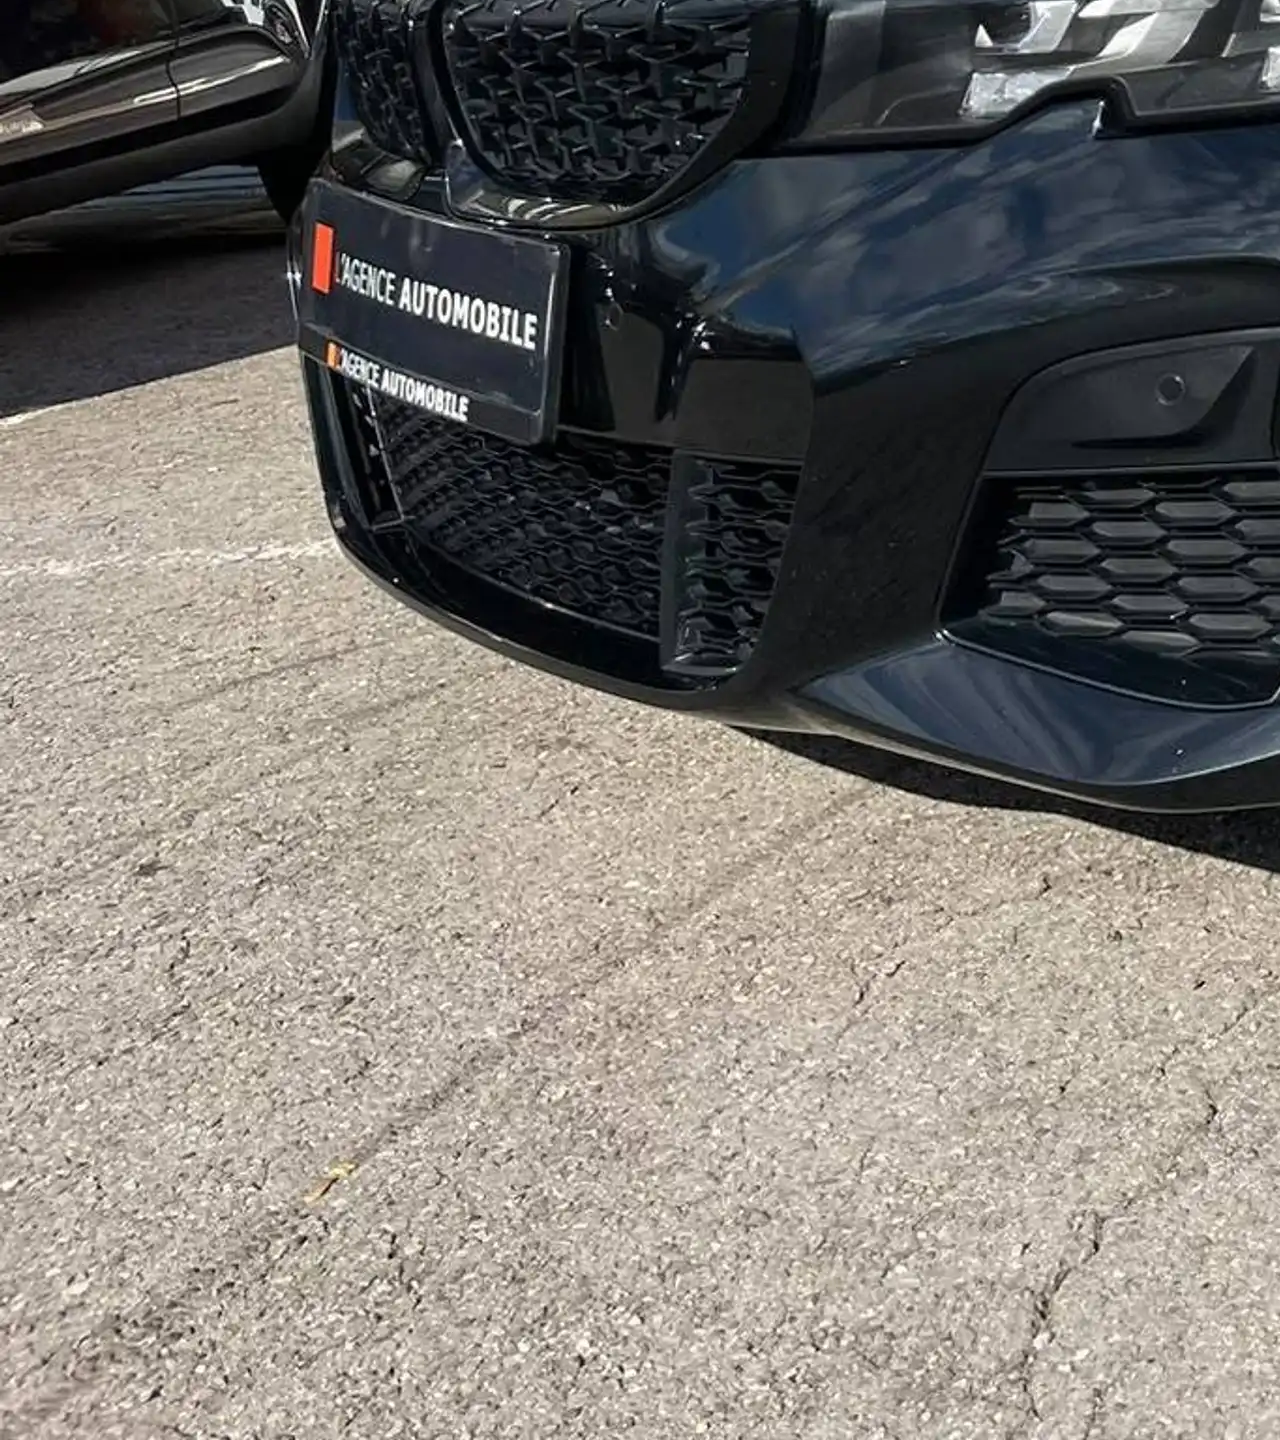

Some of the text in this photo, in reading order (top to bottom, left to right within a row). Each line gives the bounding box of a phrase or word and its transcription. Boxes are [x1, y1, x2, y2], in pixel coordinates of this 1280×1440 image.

[335, 252, 538, 350] L'AGENCE AUTOMOBILE
[381, 368, 470, 422] AUTOMOBILE
